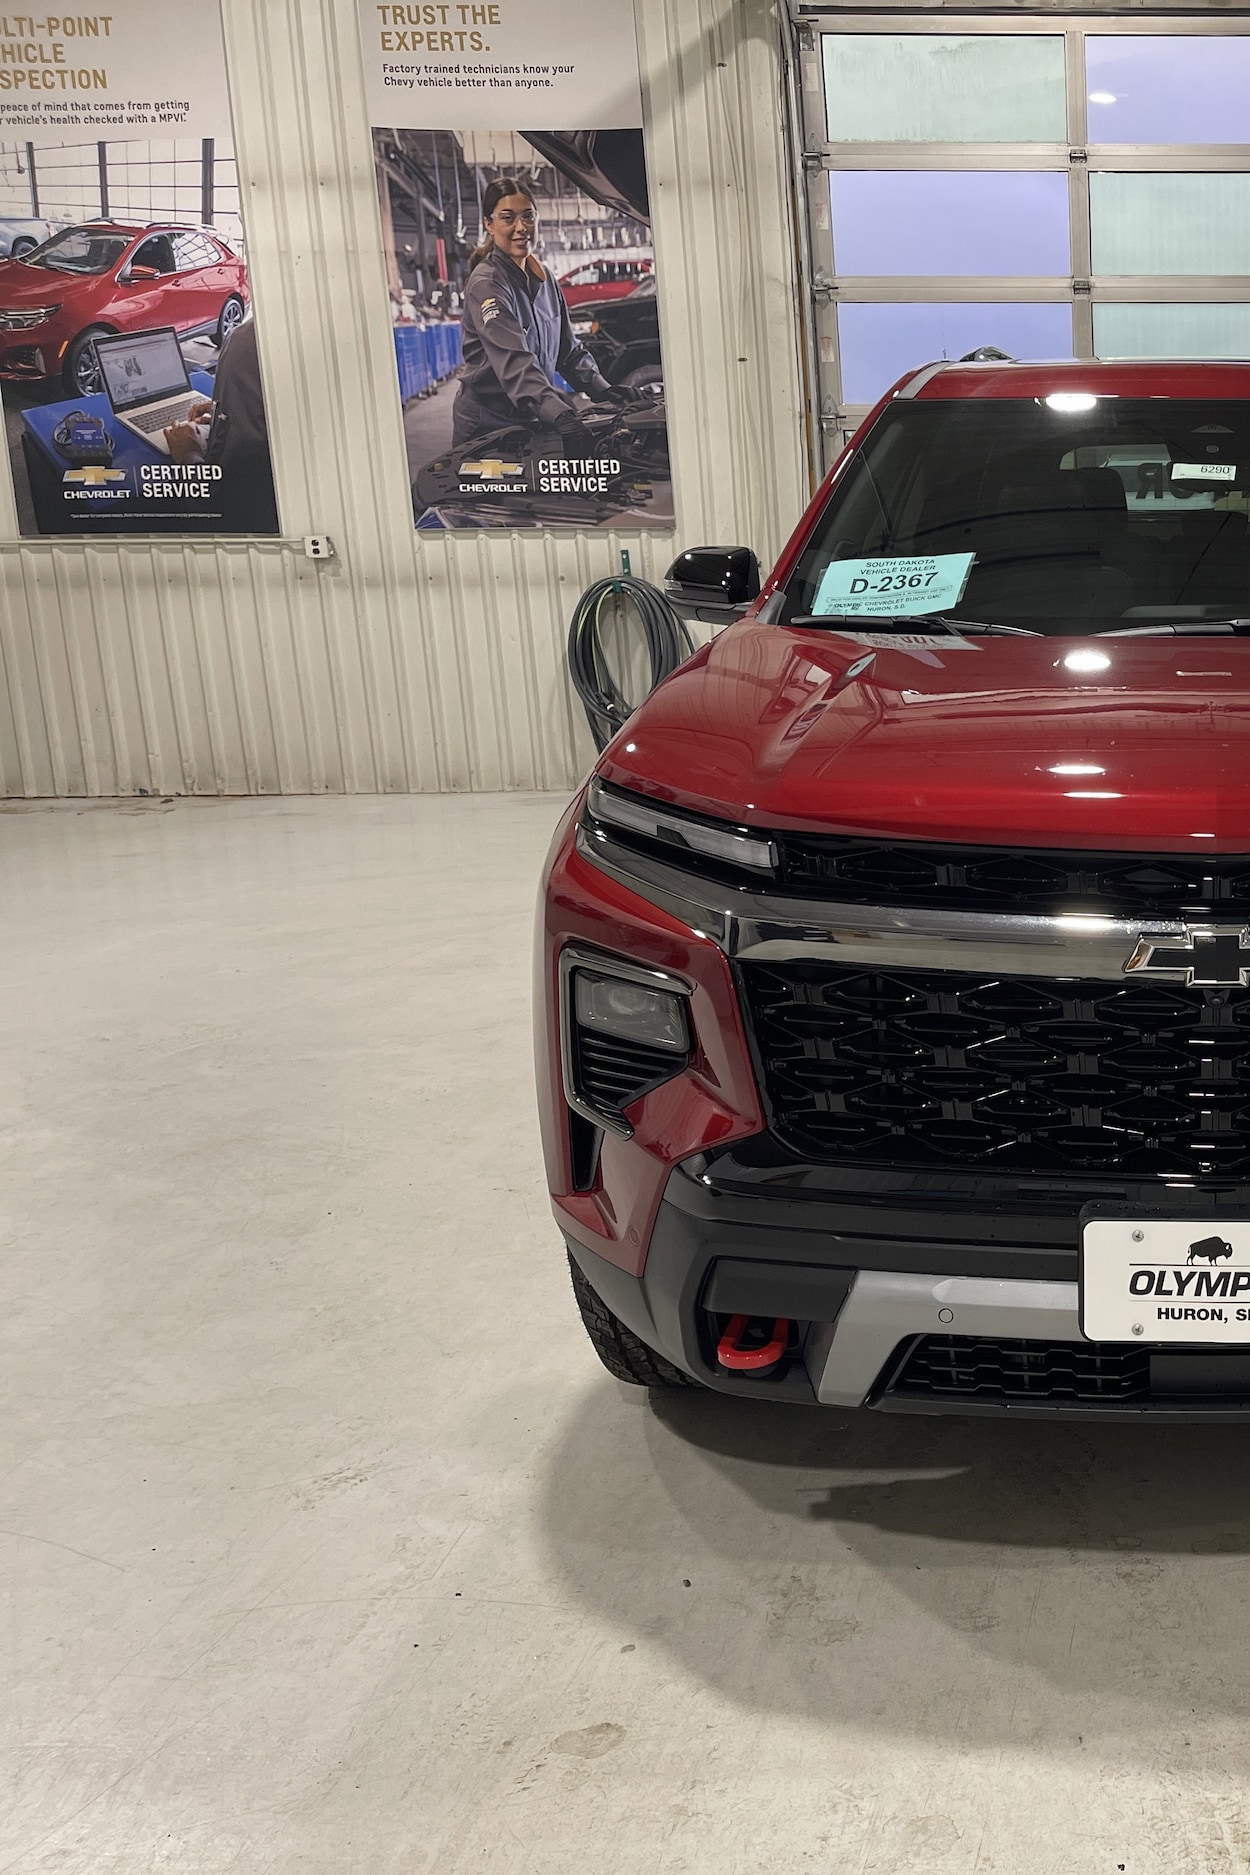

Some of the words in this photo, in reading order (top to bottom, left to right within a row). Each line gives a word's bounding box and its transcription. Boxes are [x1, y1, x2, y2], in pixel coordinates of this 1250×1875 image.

[377, 5, 450, 25] TRUST
[456, 5, 501, 25] THE
[0, 16, 113, 37] LTI-POINT
[380, 31, 490, 52] EXPERTS.
[0, 43, 66, 63] HICLE
[382, 63, 421, 76] Factory
[424, 63, 460, 74] trained
[463, 63, 521, 74] technicians
[523, 63, 550, 74] know
[552, 65, 575, 76] your
[384, 76, 415, 88] Chevy
[417, 77, 453, 87] vehicle
[455, 77, 487, 87] better
[489, 77, 512, 87] than
[515, 79, 554, 90] anyone.
[1, 103, 29, 114] peace
[32, 101, 41, 111] of
[44, 101, 68, 111] mind
[71, 101, 92, 111] that
[94, 102, 125, 111] comes
[128, 101, 152, 111] from
[154, 99, 190, 113] getting
[6, 115, 48, 125] vehicle's
[50, 114, 81, 125] health
[83, 114, 124, 124] checked
[126, 113, 148, 124] with
[150, 115, 157, 123] a
[140, 465, 222, 480] CERTIFIED
[538, 459, 621, 475] CERTIFIED
[1200, 465, 1231, 475] 6290
[143, 482, 211, 498] SERVICE
[459, 483, 528, 493] CHEVROLET
[540, 477, 609, 492] SERVICE
[63, 490, 132, 499] CHEVROLET
[860, 567, 898, 575] VEHICLE
[865, 560, 897, 568] SOUTH
[849, 571, 939, 594] D-2367
[864, 598, 904, 606] CHEVROLET
[904, 595, 926, 603] BUICK
[1157, 1307, 1229, 1324] HURON,
